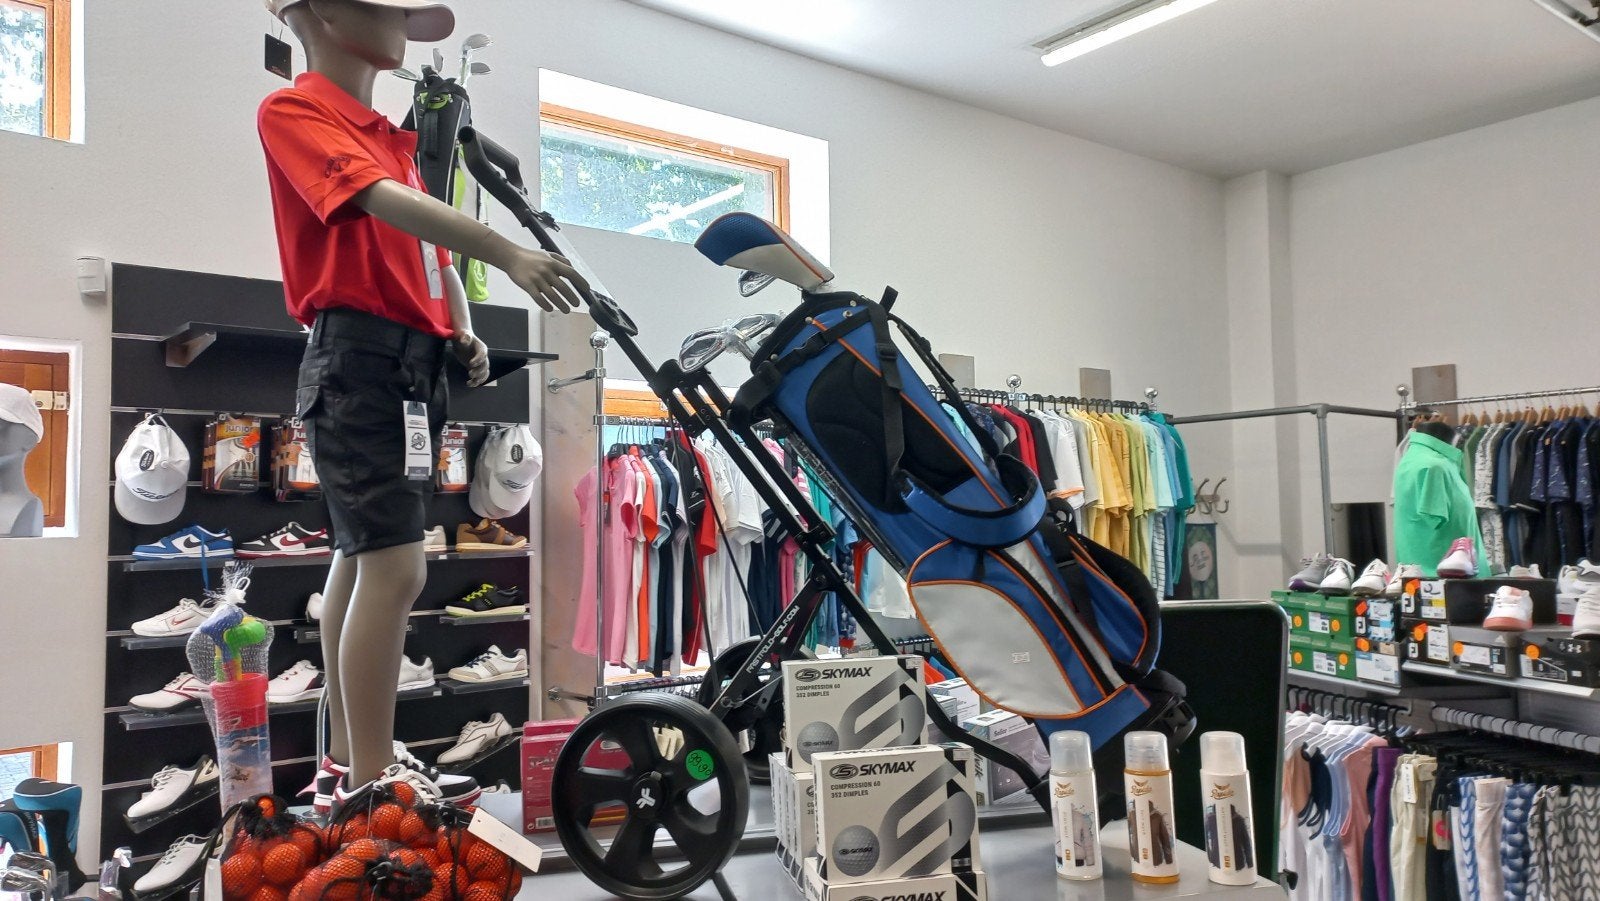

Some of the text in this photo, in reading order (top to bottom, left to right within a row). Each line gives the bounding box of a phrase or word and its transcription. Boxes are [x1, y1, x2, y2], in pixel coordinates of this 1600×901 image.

[821, 666, 873, 680] SKYMAX
[858, 760, 917, 777] SKYMAX
[830, 780, 881, 791] COMPRESSION 60
[843, 789, 869, 798] DIMPLES
[879, 890, 948, 901] YMAX
